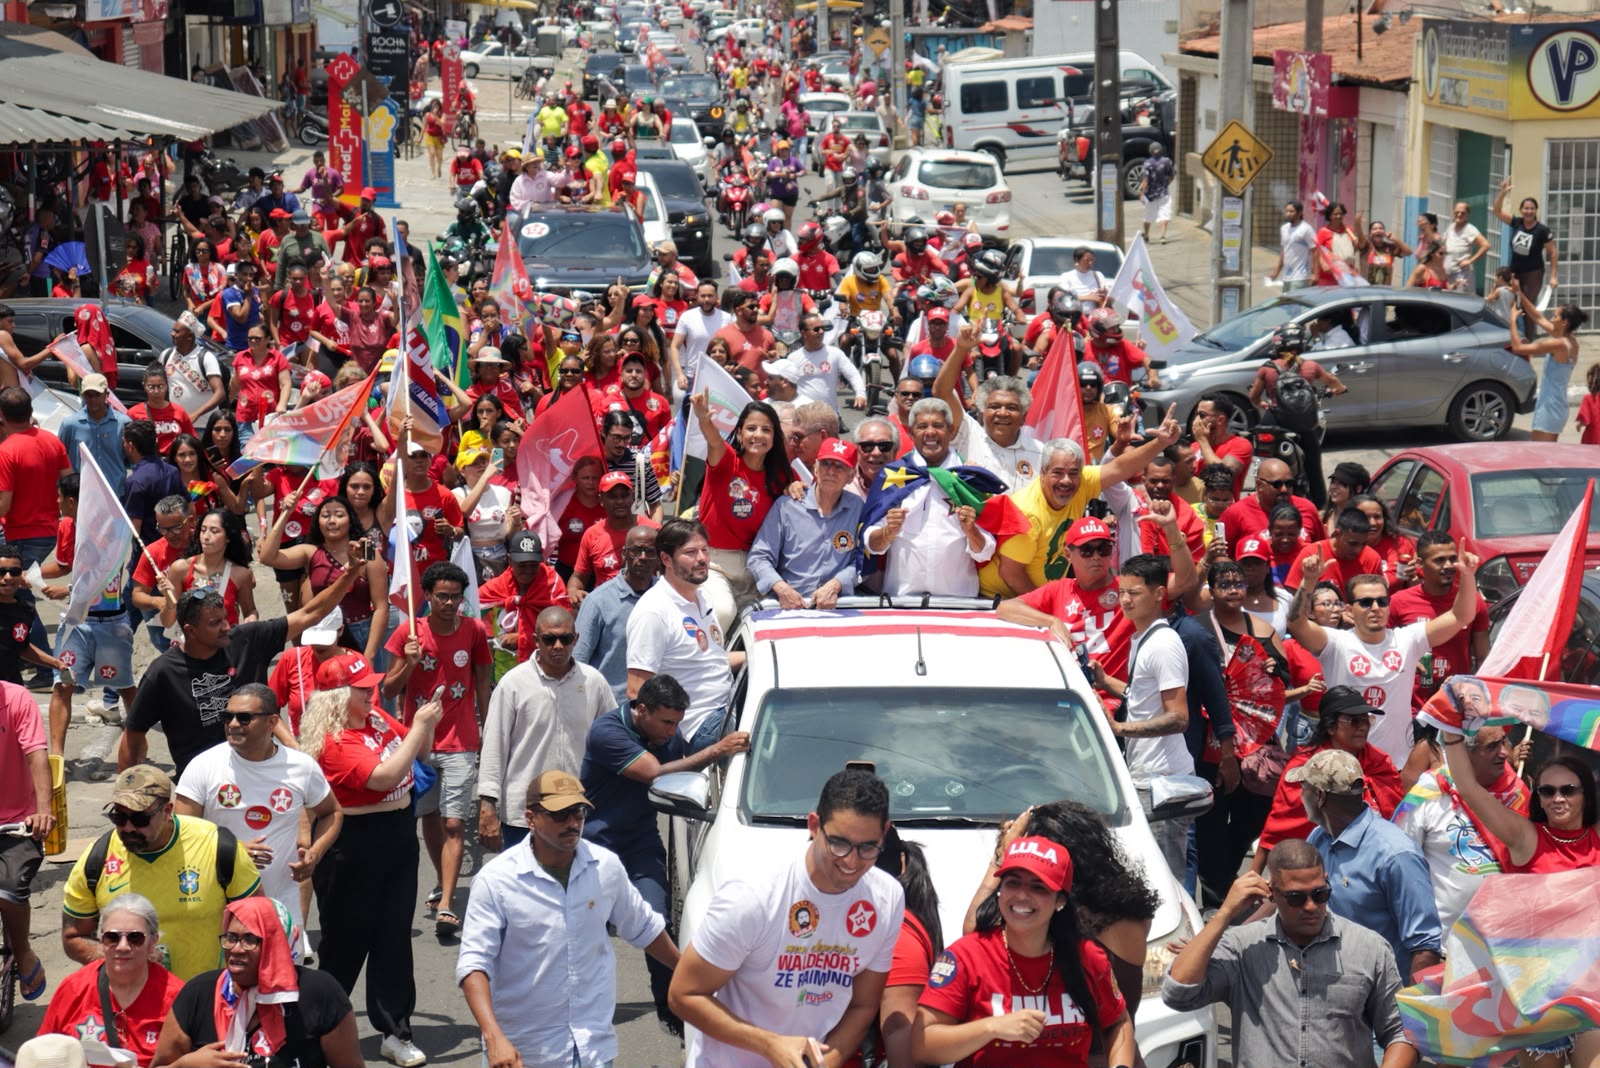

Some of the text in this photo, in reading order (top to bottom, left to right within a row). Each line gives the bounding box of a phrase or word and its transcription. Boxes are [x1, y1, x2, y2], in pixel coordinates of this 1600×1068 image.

[371, 37, 406, 47] ROCHA
[1546, 37, 1598, 105] VP
[340, 153, 352, 184] Med
[550, 305, 562, 318] 13
[1154, 315, 1175, 336] 13
[1080, 523, 1104, 535] LULA
[1243, 539, 1260, 553] 13
[1357, 662, 1365, 670] 13
[1434, 658, 1448, 669] LULA
[1368, 687, 1382, 699] LULA
[1008, 841, 1058, 865] LULA
[107, 860, 118, 871] 13
[854, 912, 866, 927] 13
[774, 968, 852, 989] ZÉ RAIMUND
[85, 1025, 95, 1035] 13
[145, 1031, 157, 1043] 13
